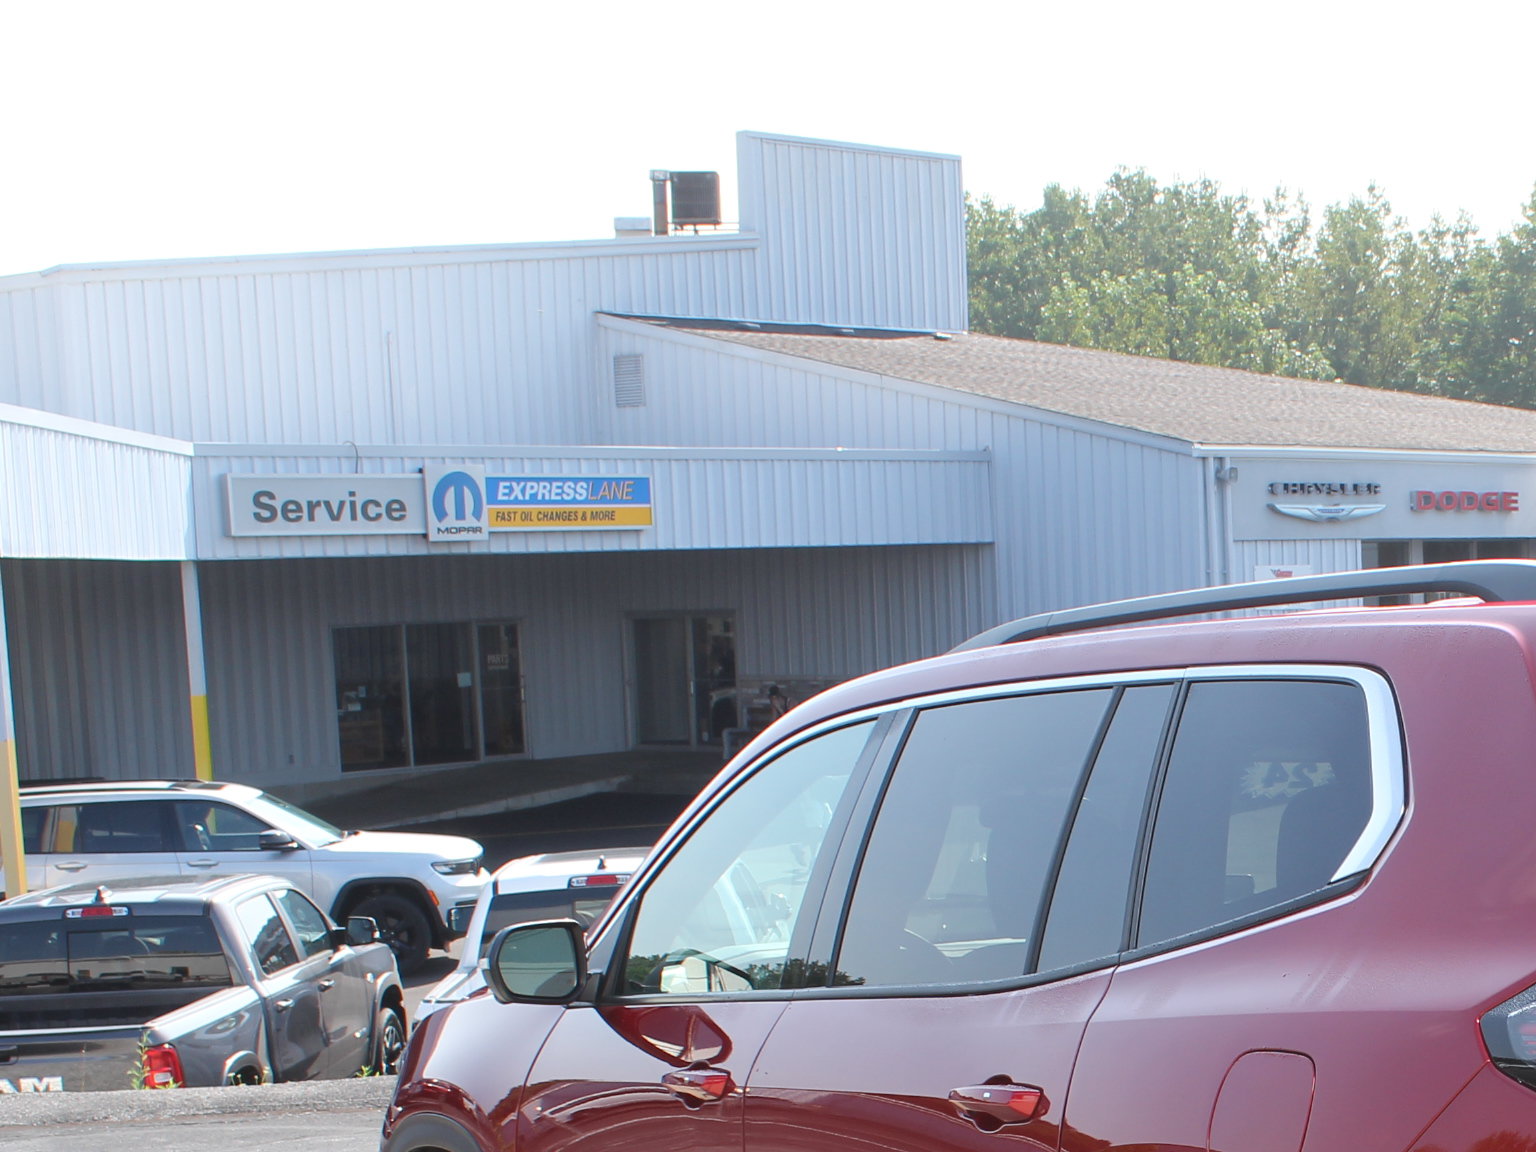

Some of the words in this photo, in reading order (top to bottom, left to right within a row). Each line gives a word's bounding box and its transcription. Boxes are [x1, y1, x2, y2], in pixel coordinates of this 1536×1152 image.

[1268, 482, 1382, 496] CHRYSLER
[252, 489, 407, 524] Service
[1411, 490, 1520, 512] DODGE
[496, 511, 516, 522] FAST
[520, 511, 533, 522] OIL
[537, 510, 578, 522] CHANGES
[581, 510, 587, 521] &
[590, 510, 616, 521] MORE
[437, 526, 482, 535] MOPAR
